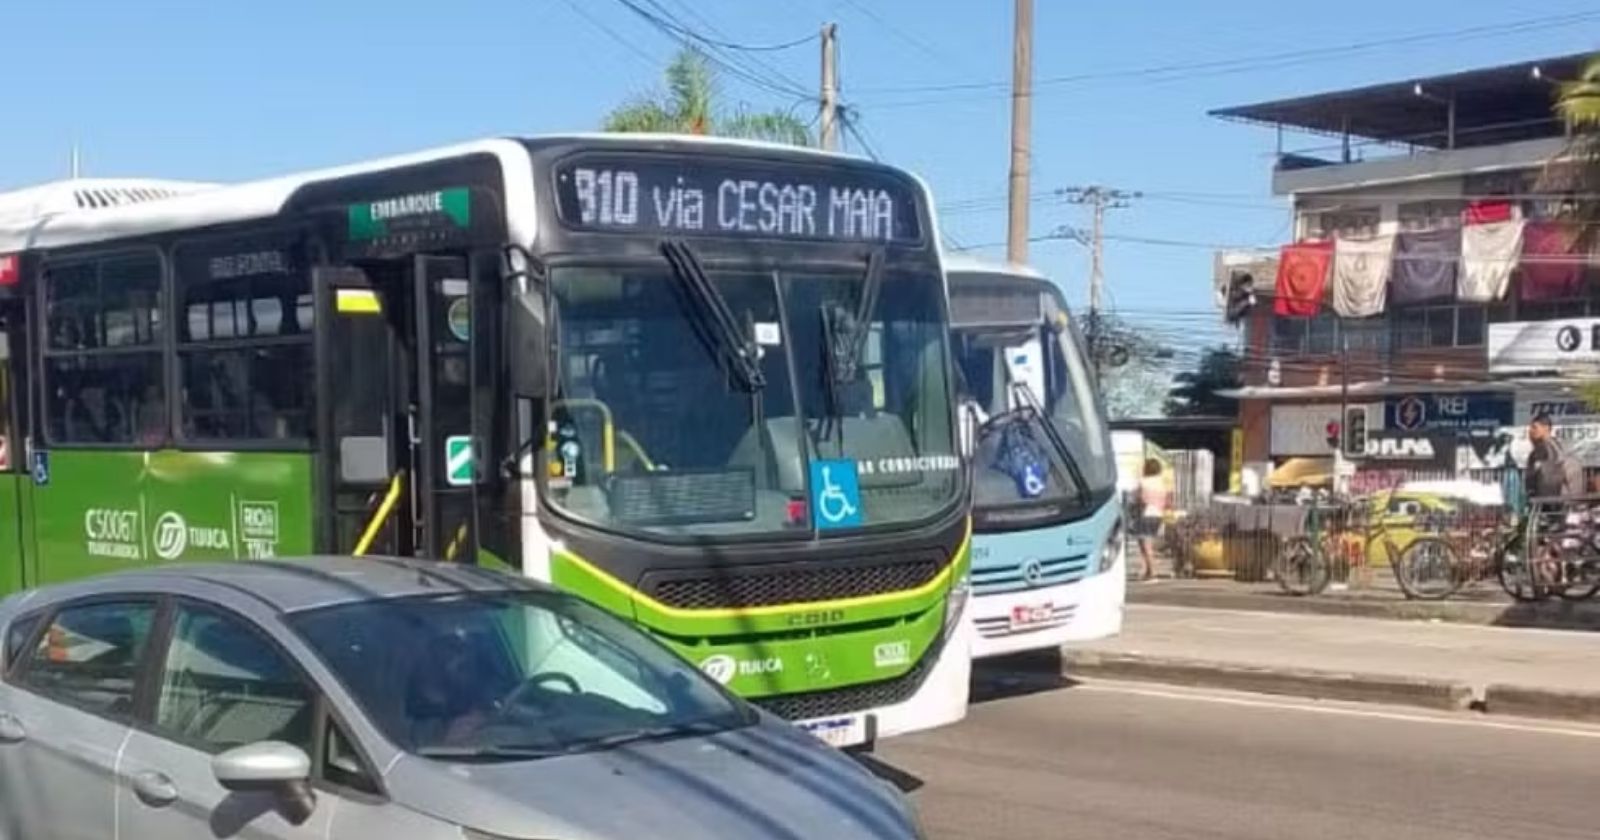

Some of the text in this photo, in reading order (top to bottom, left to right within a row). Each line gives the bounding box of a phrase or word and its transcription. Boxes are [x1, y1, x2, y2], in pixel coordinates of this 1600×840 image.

[653, 177, 703, 230] via
[717, 179, 816, 235] CESAR
[829, 187, 892, 241] MAIA
